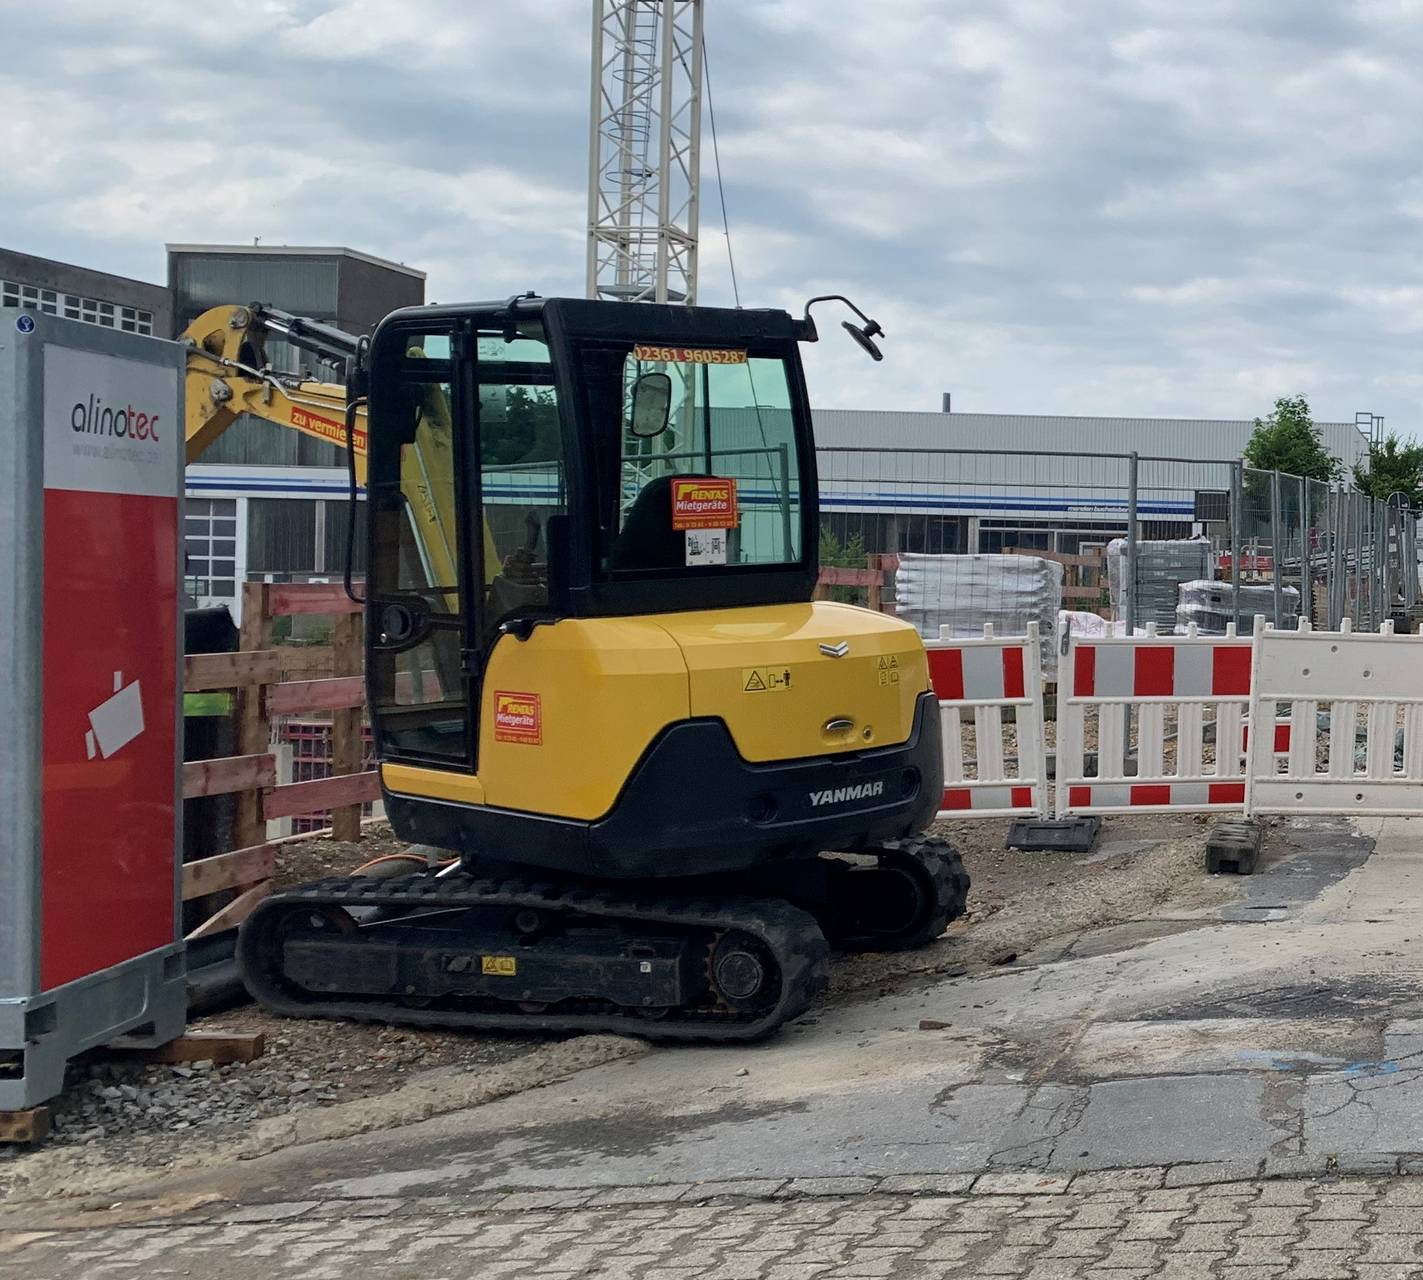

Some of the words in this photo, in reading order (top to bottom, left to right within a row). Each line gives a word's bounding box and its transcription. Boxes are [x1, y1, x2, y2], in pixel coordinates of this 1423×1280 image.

[634, 347, 679, 361] 02361
[685, 349, 746, 364] 9605287
[72, 393, 159, 442] alinotec
[292, 412, 306, 426] zu
[308, 418, 364, 447] vermieen
[676, 500, 727, 512] Mietgeräte
[809, 781, 883, 806] YANMAR
